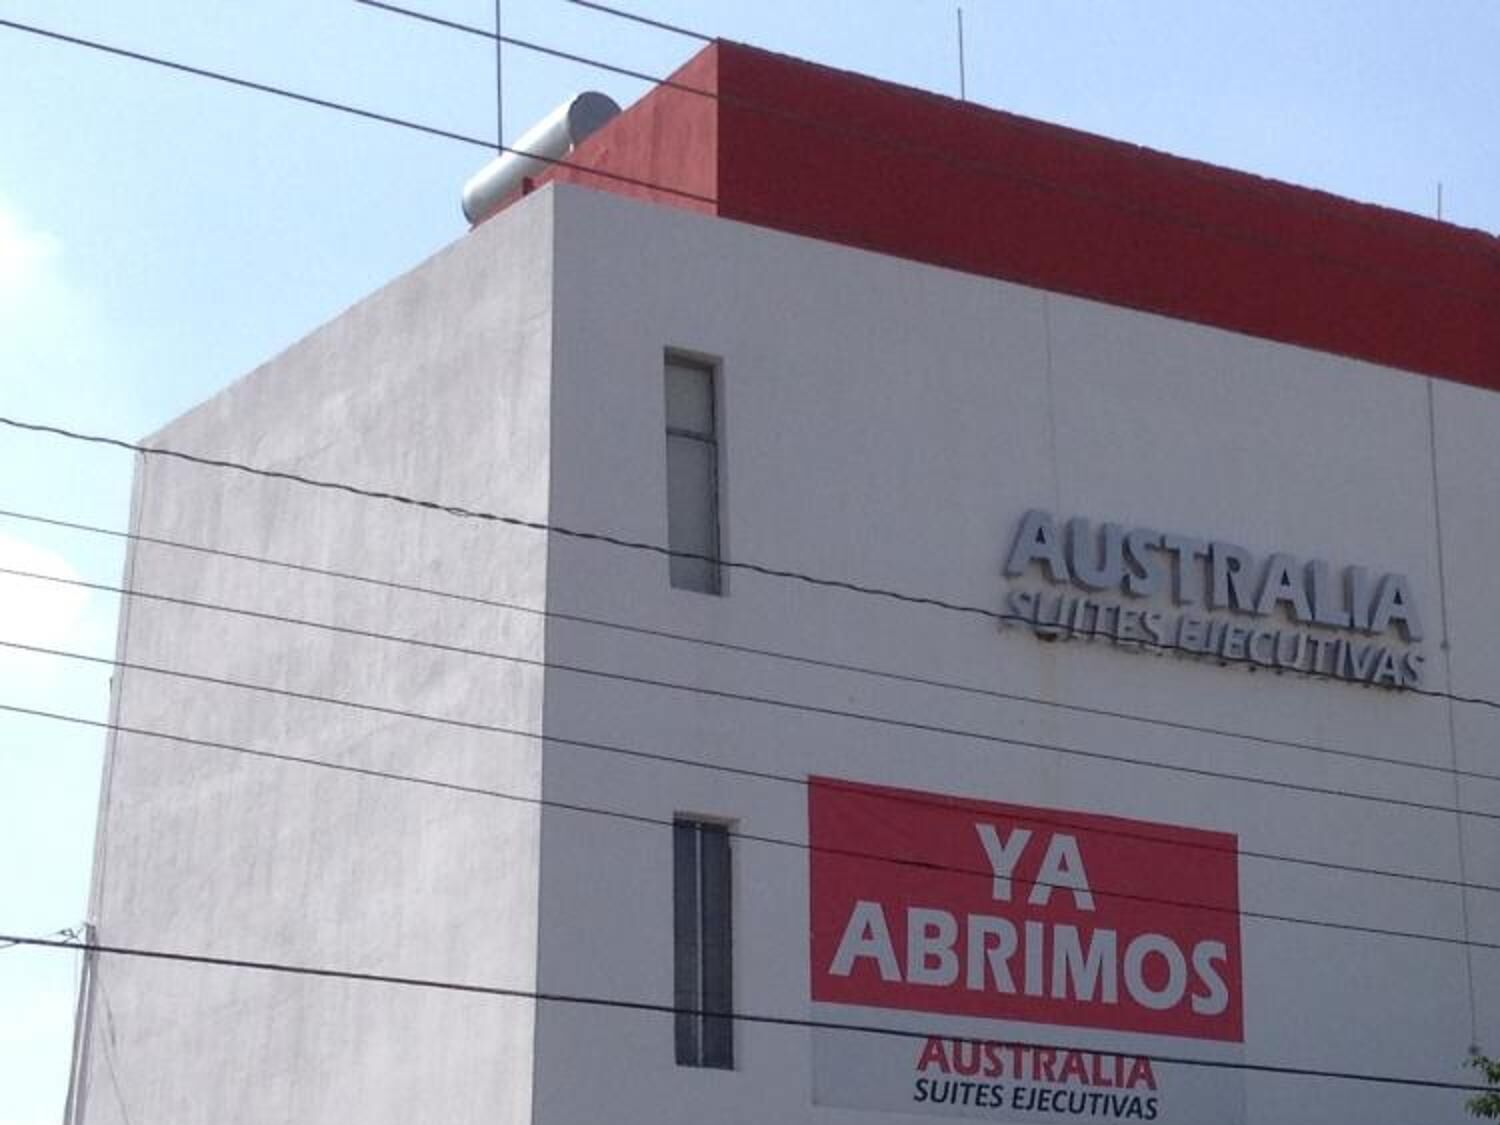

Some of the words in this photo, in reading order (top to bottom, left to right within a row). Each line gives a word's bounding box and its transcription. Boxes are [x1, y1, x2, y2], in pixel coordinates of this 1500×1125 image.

[1003, 509, 1424, 644] AUSTRALIA
[1002, 590, 1168, 652] SUITES
[1174, 613, 1425, 690] EJECUTIVAS
[975, 823, 1097, 912] YA
[828, 899, 1229, 1016] ABRIMOS
[913, 1077, 1004, 1109] SUITES
[1011, 1086, 1158, 1122] EJECUTIVAS
[916, 1034, 1158, 1091] AUSTRALIA
